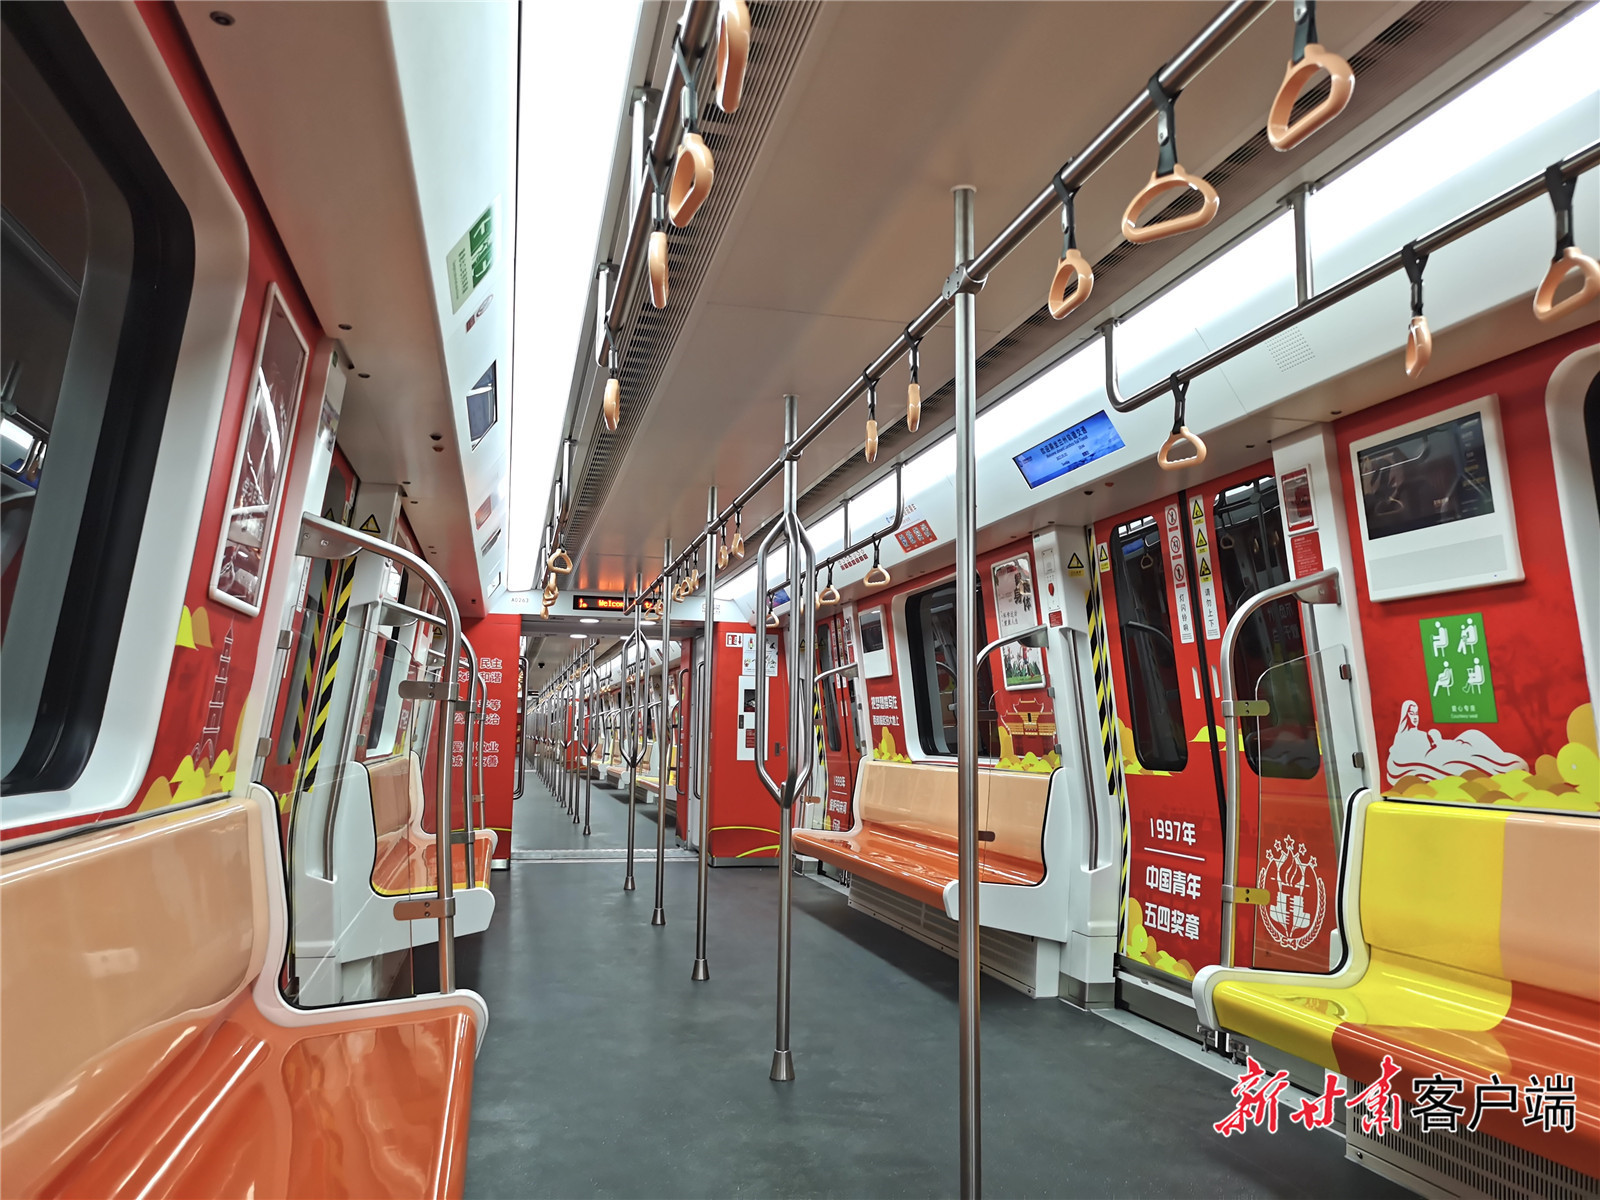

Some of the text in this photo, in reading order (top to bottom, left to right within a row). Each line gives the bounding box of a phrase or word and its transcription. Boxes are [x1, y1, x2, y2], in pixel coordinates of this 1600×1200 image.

[1180, 594, 1189, 632] 灯闪铃响
[1205, 588, 1214, 627] 请勿上下
[478, 671, 502, 683] 和谐
[480, 658, 502, 669] 民主
[1451, 704, 1476, 712] 爱心专座
[1149, 817, 1197, 846] 1997年
[1145, 864, 1202, 900] 中国青年
[1143, 901, 1200, 941] 五四奖章
